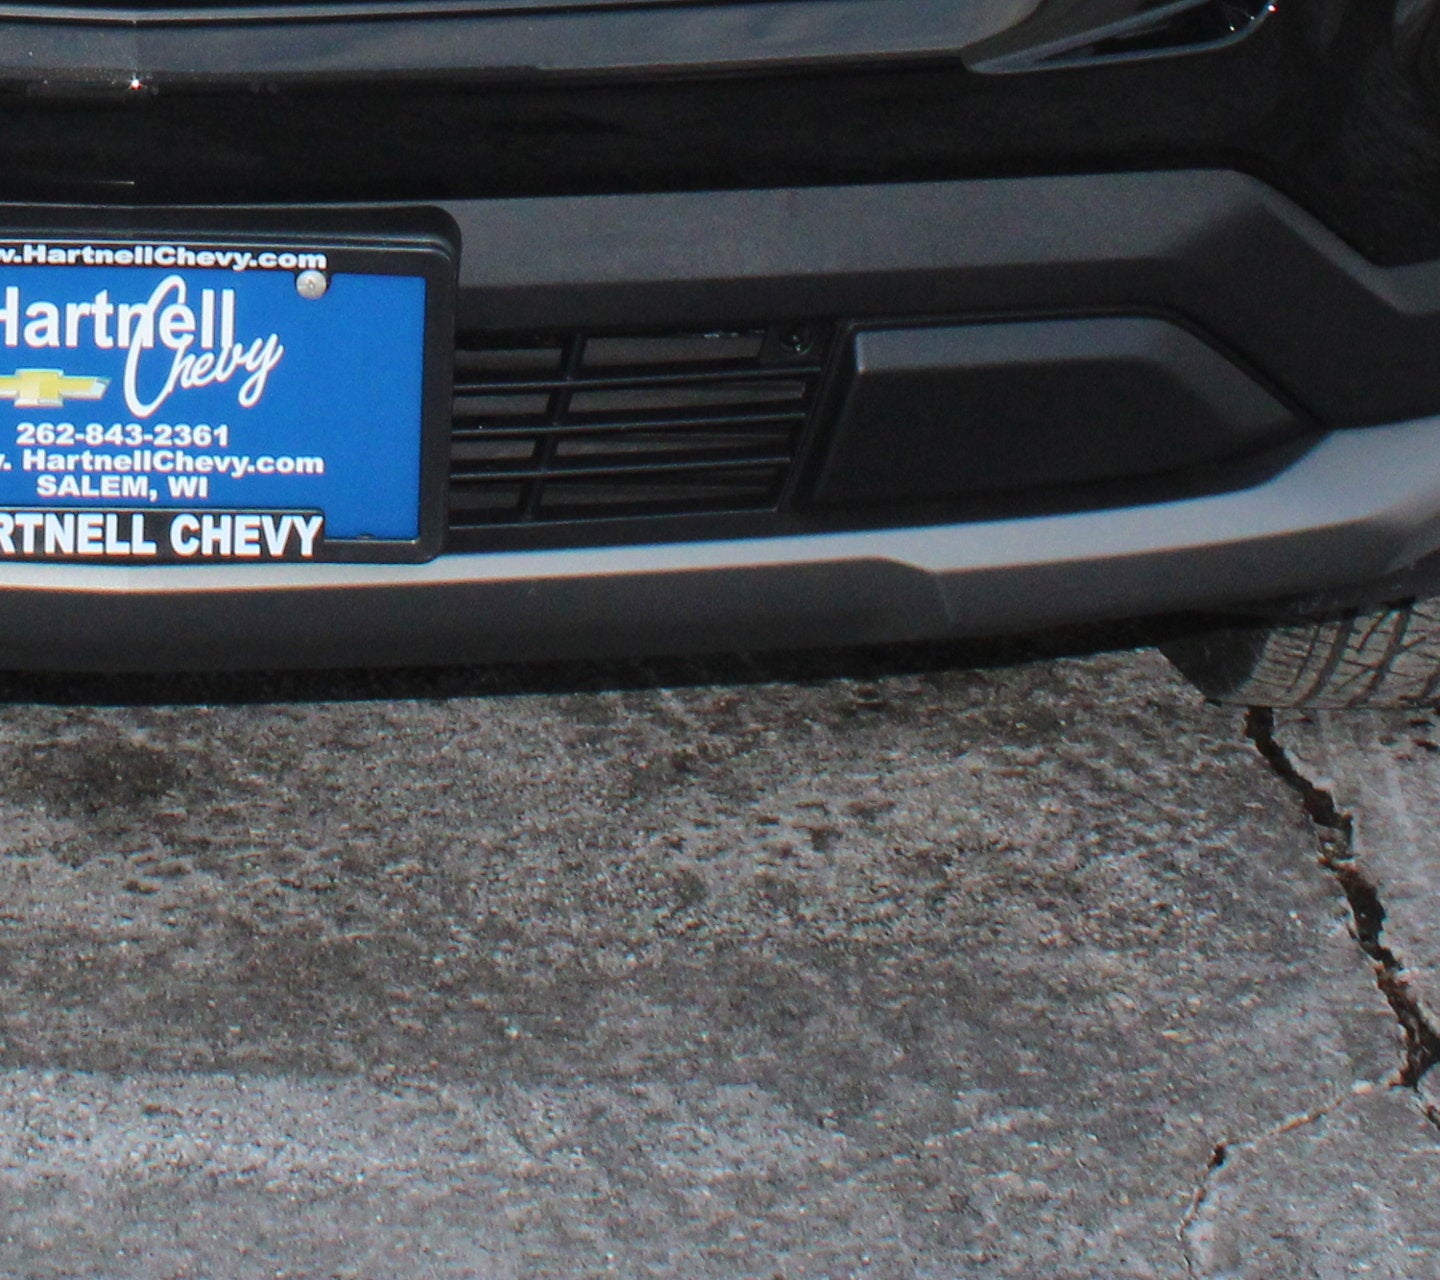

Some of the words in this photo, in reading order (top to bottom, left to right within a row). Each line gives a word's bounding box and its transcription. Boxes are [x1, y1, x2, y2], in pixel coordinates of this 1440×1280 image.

[124, 274, 284, 418] Chevy
[16, 422, 229, 446] 262-843-2361
[23, 448, 324, 478] HartnellChevy.com
[36, 474, 158, 502] SALEM,
[168, 475, 208, 498] WI
[170, 513, 324, 557] CHEVY
